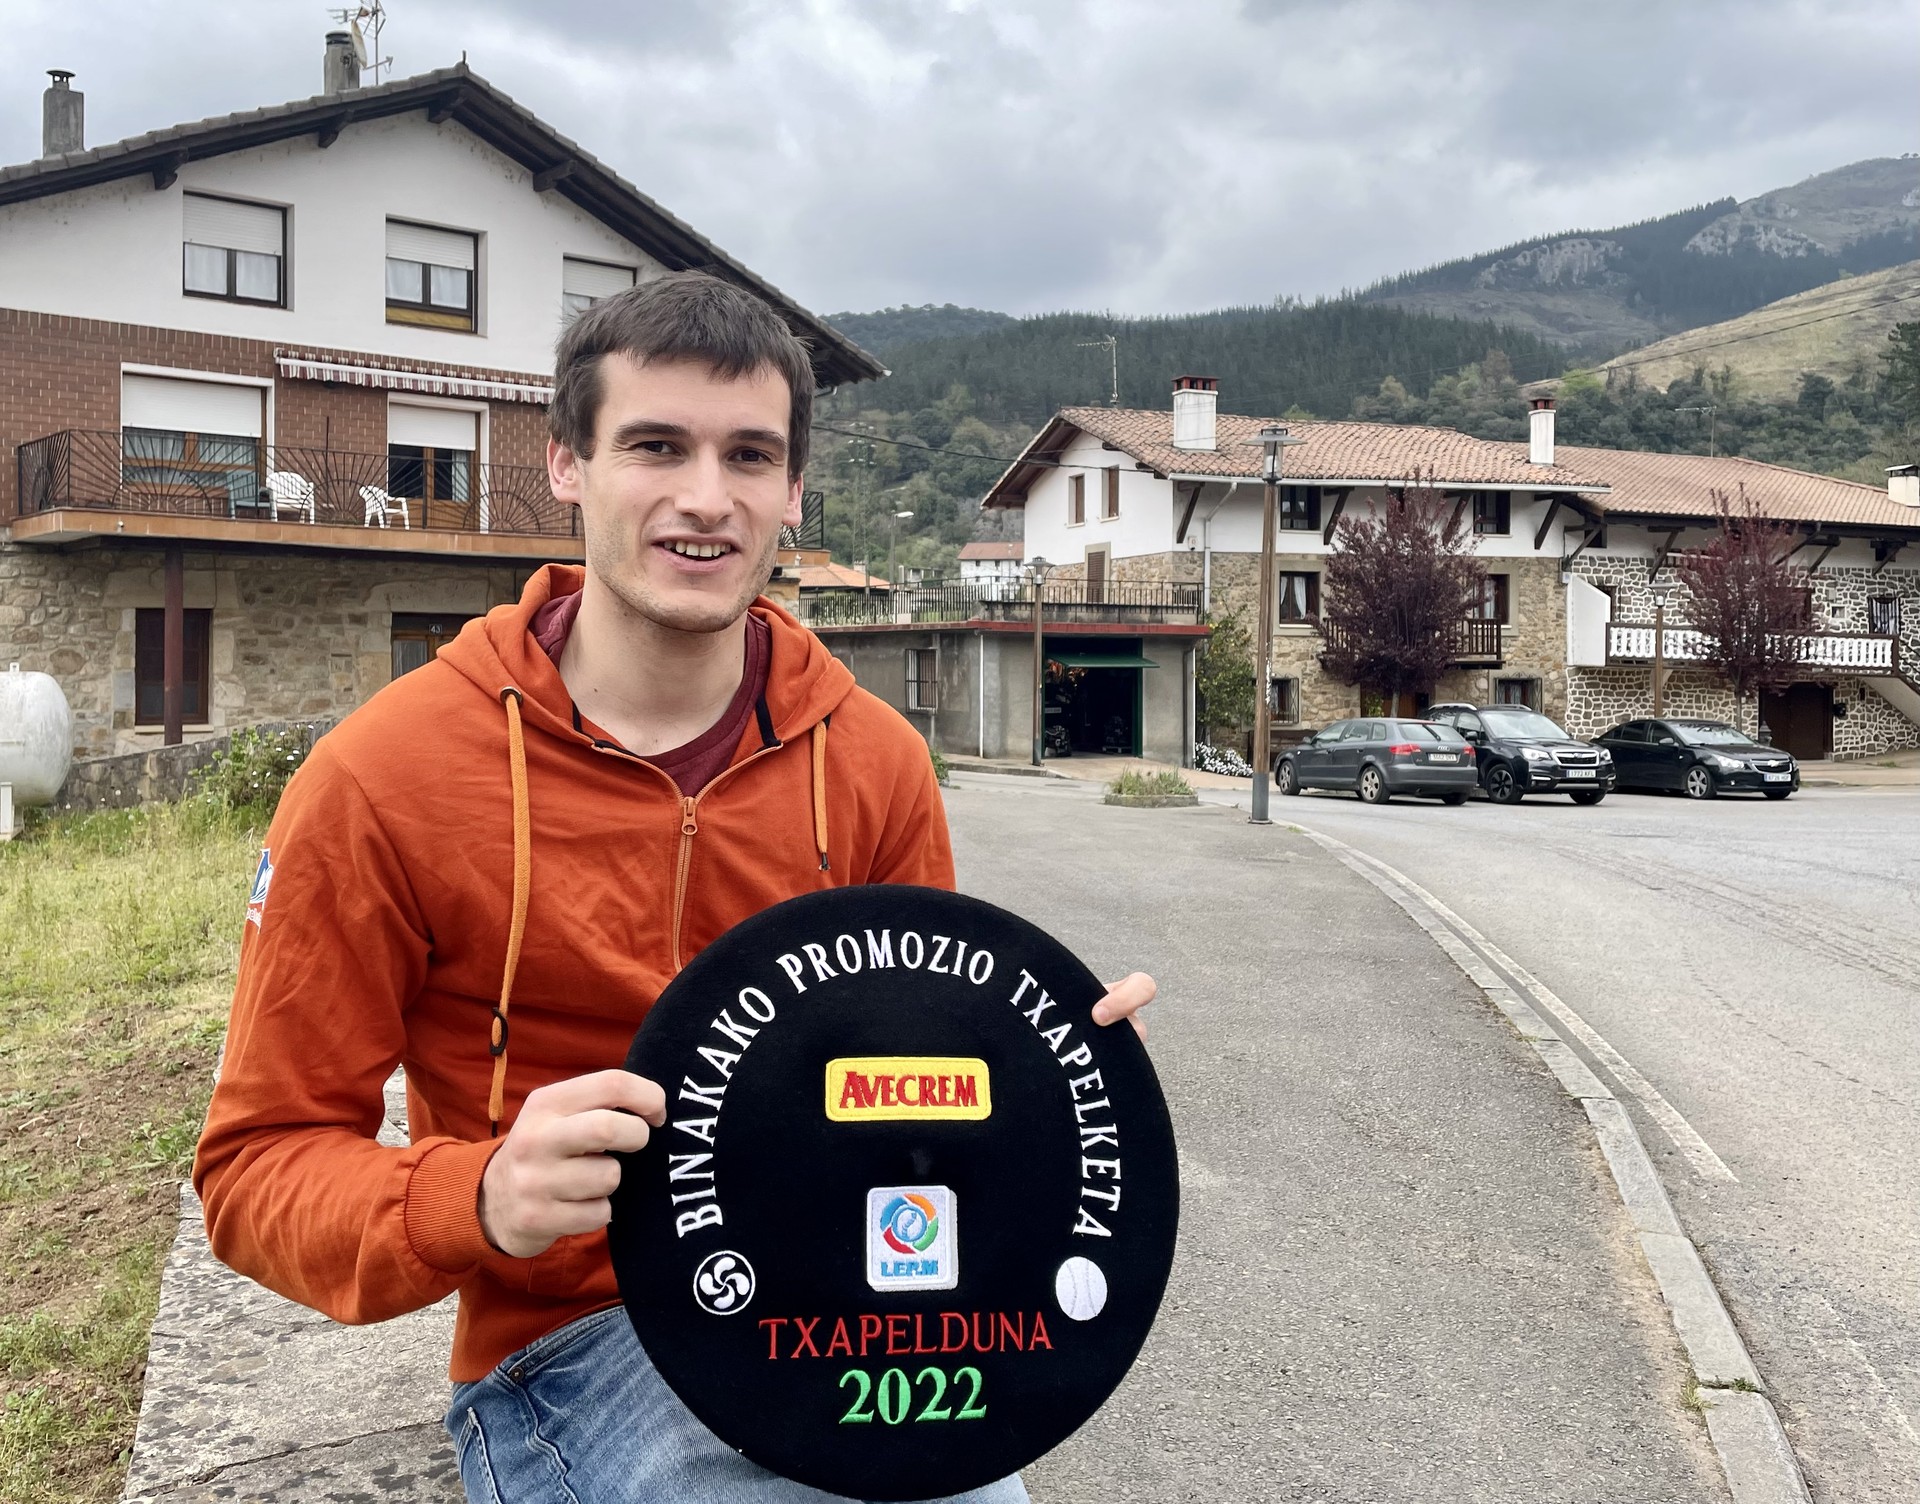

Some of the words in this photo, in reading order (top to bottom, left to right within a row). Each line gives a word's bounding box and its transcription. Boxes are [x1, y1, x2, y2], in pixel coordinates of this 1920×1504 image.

[669, 987, 776, 1239] BINAKAKO
[776, 929, 995, 994] PROMOZIO
[1009, 969, 1122, 1238] TXAPELKETA
[839, 1071, 979, 1109] AVECREM
[759, 1312, 1054, 1360] TXAPELDUNA
[839, 1367, 987, 1425] 2022
